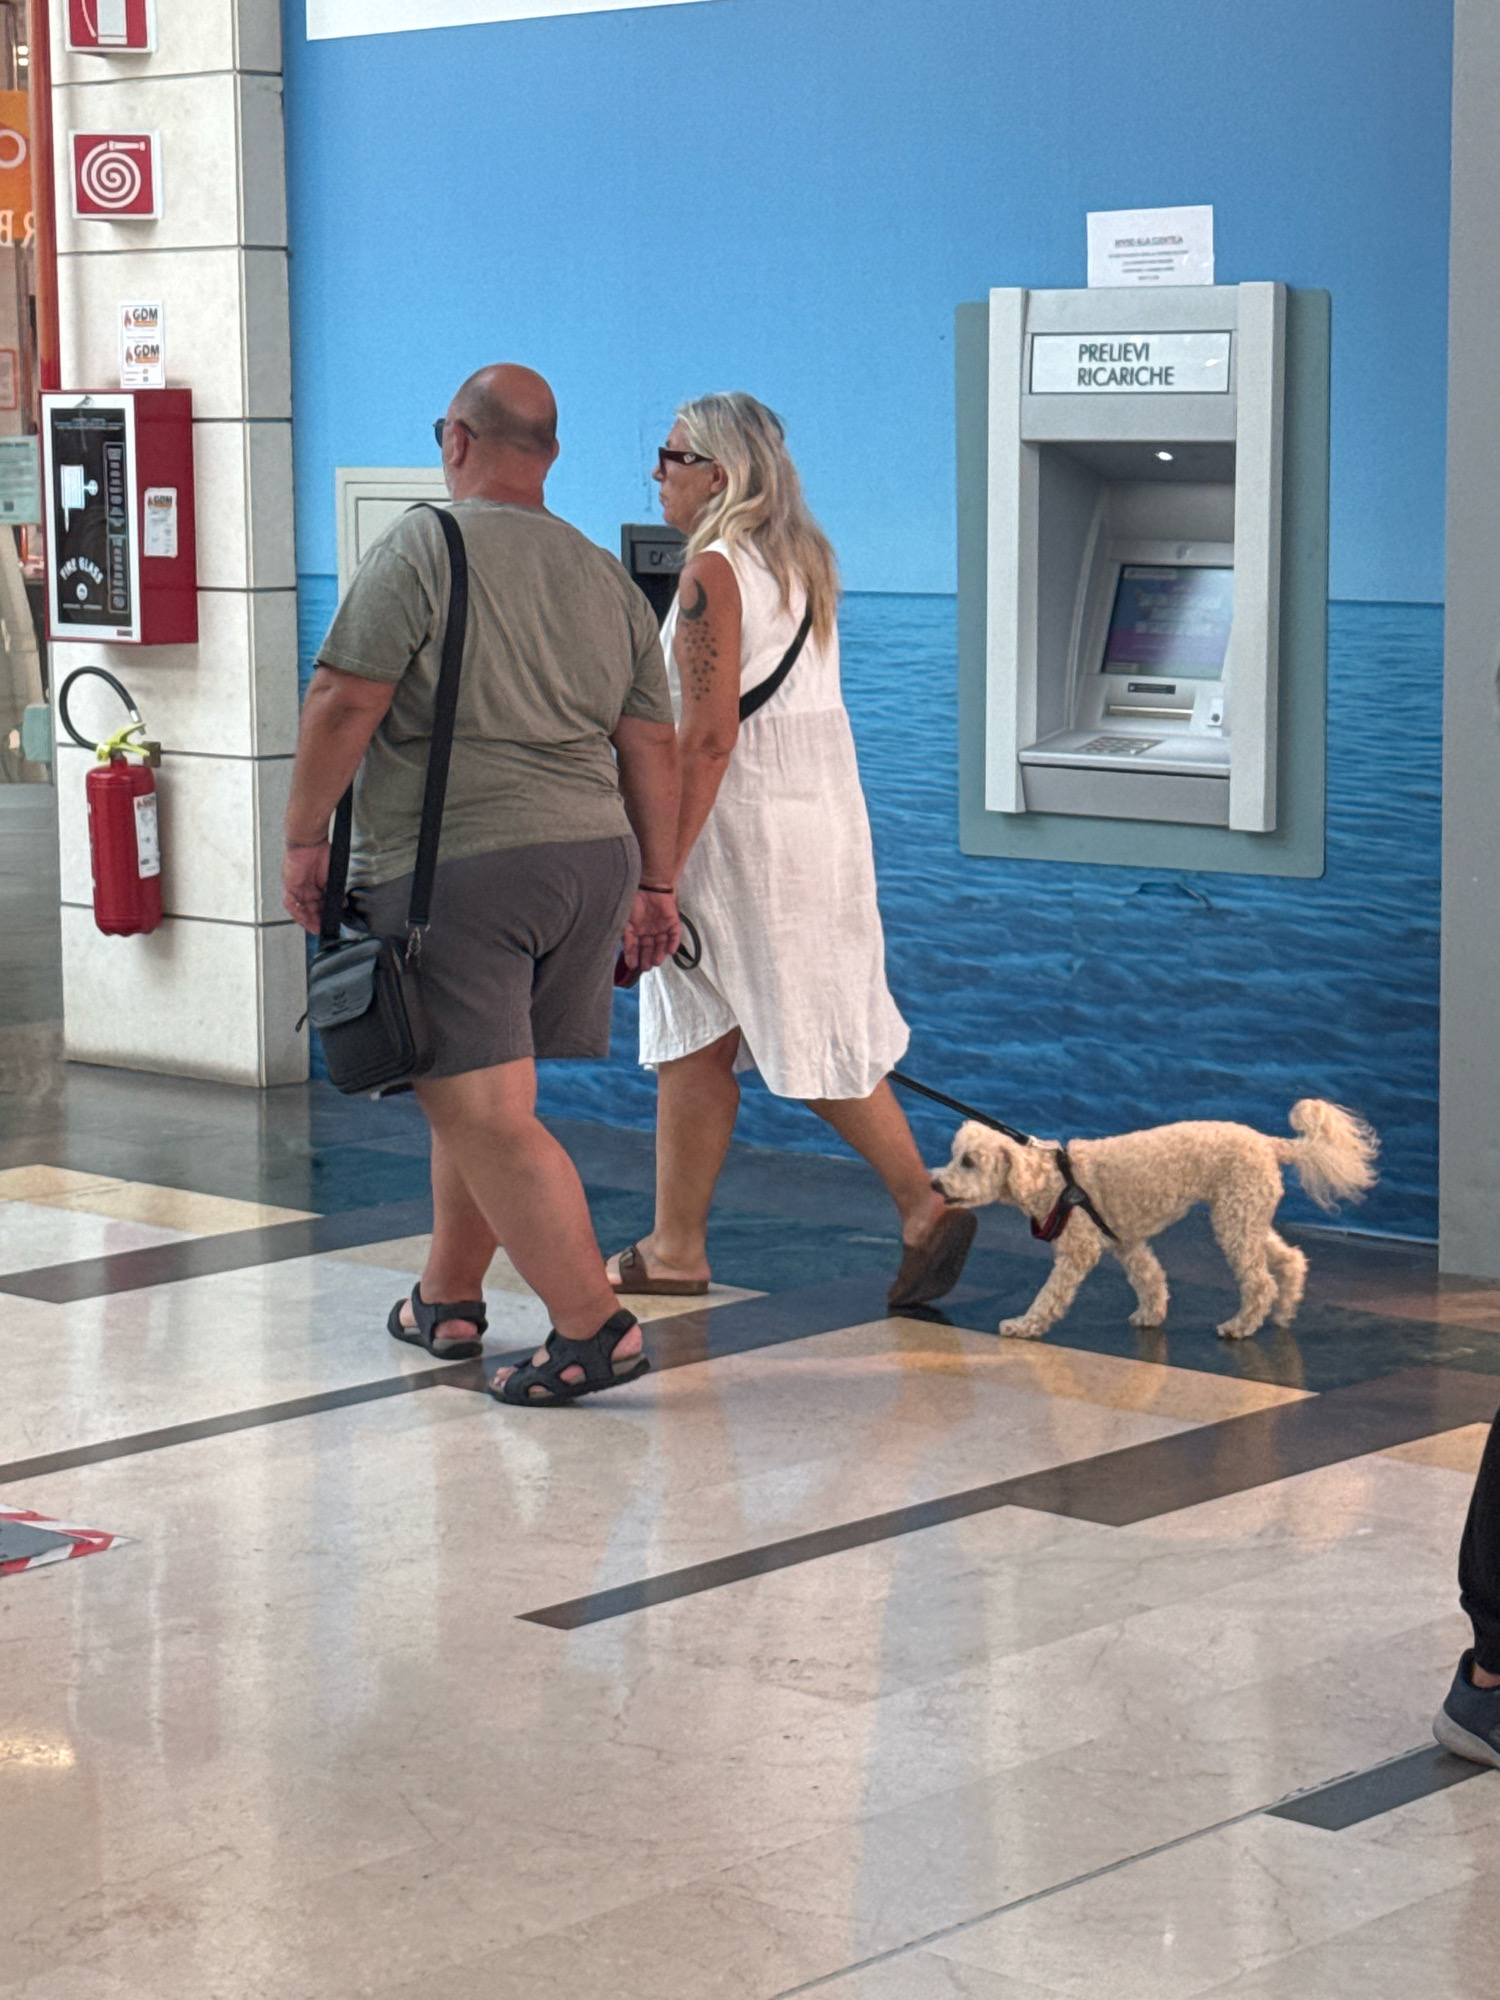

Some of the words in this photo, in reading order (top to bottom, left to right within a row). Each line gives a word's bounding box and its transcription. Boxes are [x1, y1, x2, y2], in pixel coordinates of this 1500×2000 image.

[133, 307, 158, 321] GDM
[134, 344, 160, 358] GDM
[1078, 342, 1150, 362] PRELIEVI
[1077, 366, 1175, 387] RICARICHE
[60, 557, 77, 580] FIRE
[78, 556, 104, 585] GLASS
